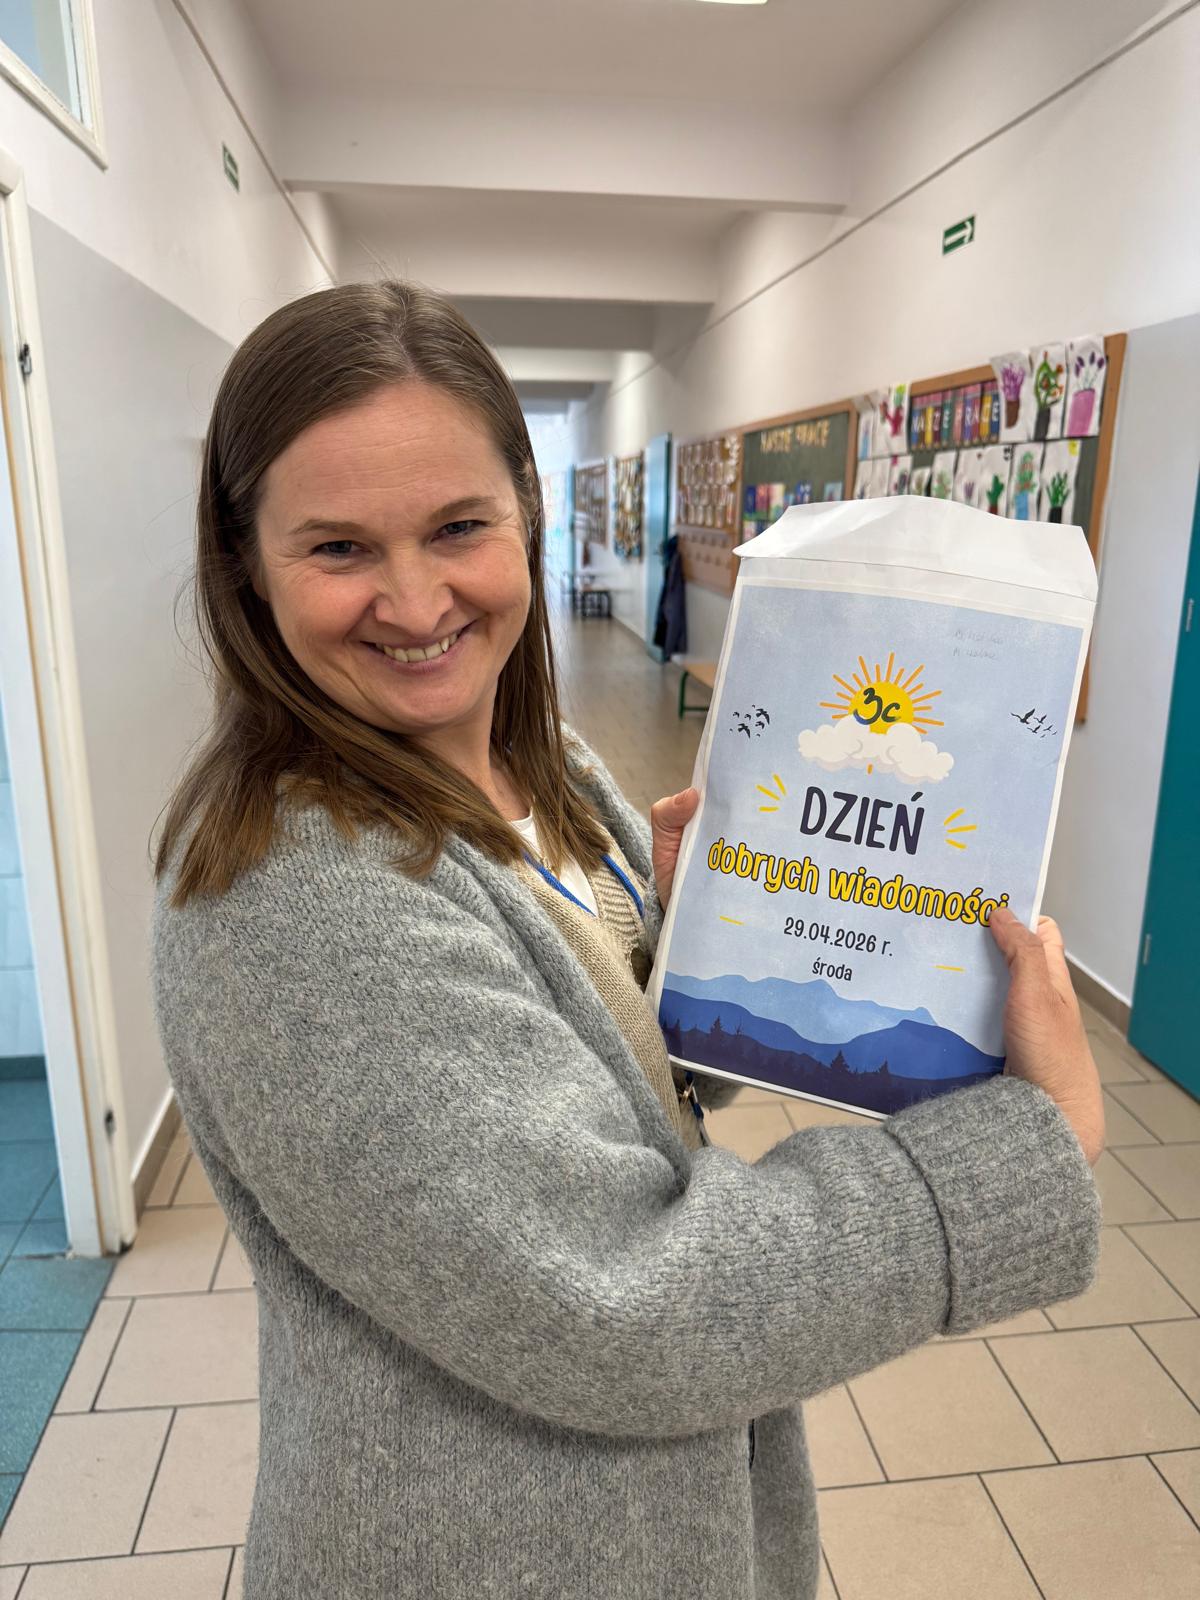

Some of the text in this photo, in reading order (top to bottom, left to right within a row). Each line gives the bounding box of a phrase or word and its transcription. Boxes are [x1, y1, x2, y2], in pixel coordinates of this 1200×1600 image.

[853, 687, 901, 725] 3c
[800, 786, 924, 855] DZIEŃ
[708, 838, 819, 894] dobrych
[784, 917, 892, 956] 29.04.2026 r.
[812, 957, 852, 981] środa
